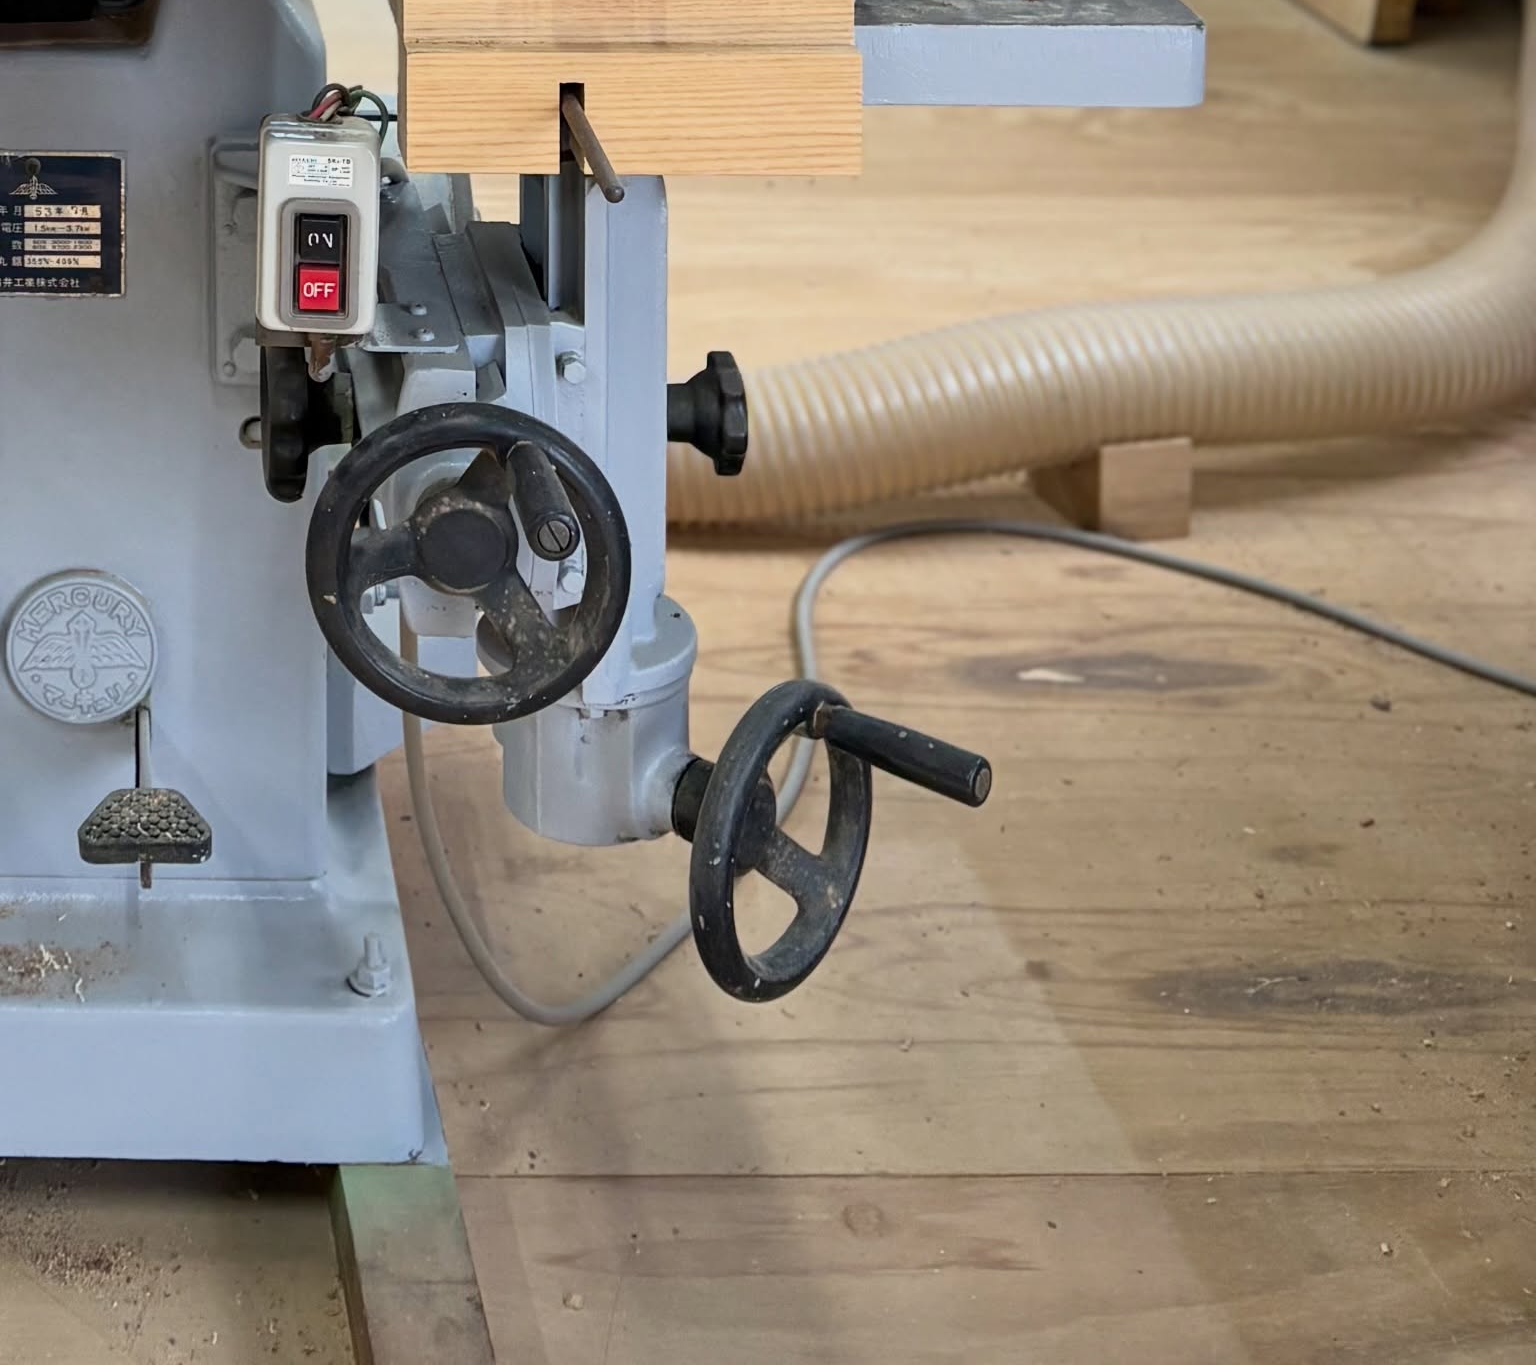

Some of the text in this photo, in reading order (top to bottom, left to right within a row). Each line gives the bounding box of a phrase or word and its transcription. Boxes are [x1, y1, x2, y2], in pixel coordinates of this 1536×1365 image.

[307, 232, 333, 249] ON
[303, 281, 337, 299] OFF
[16, 586, 148, 644] MERCURY
